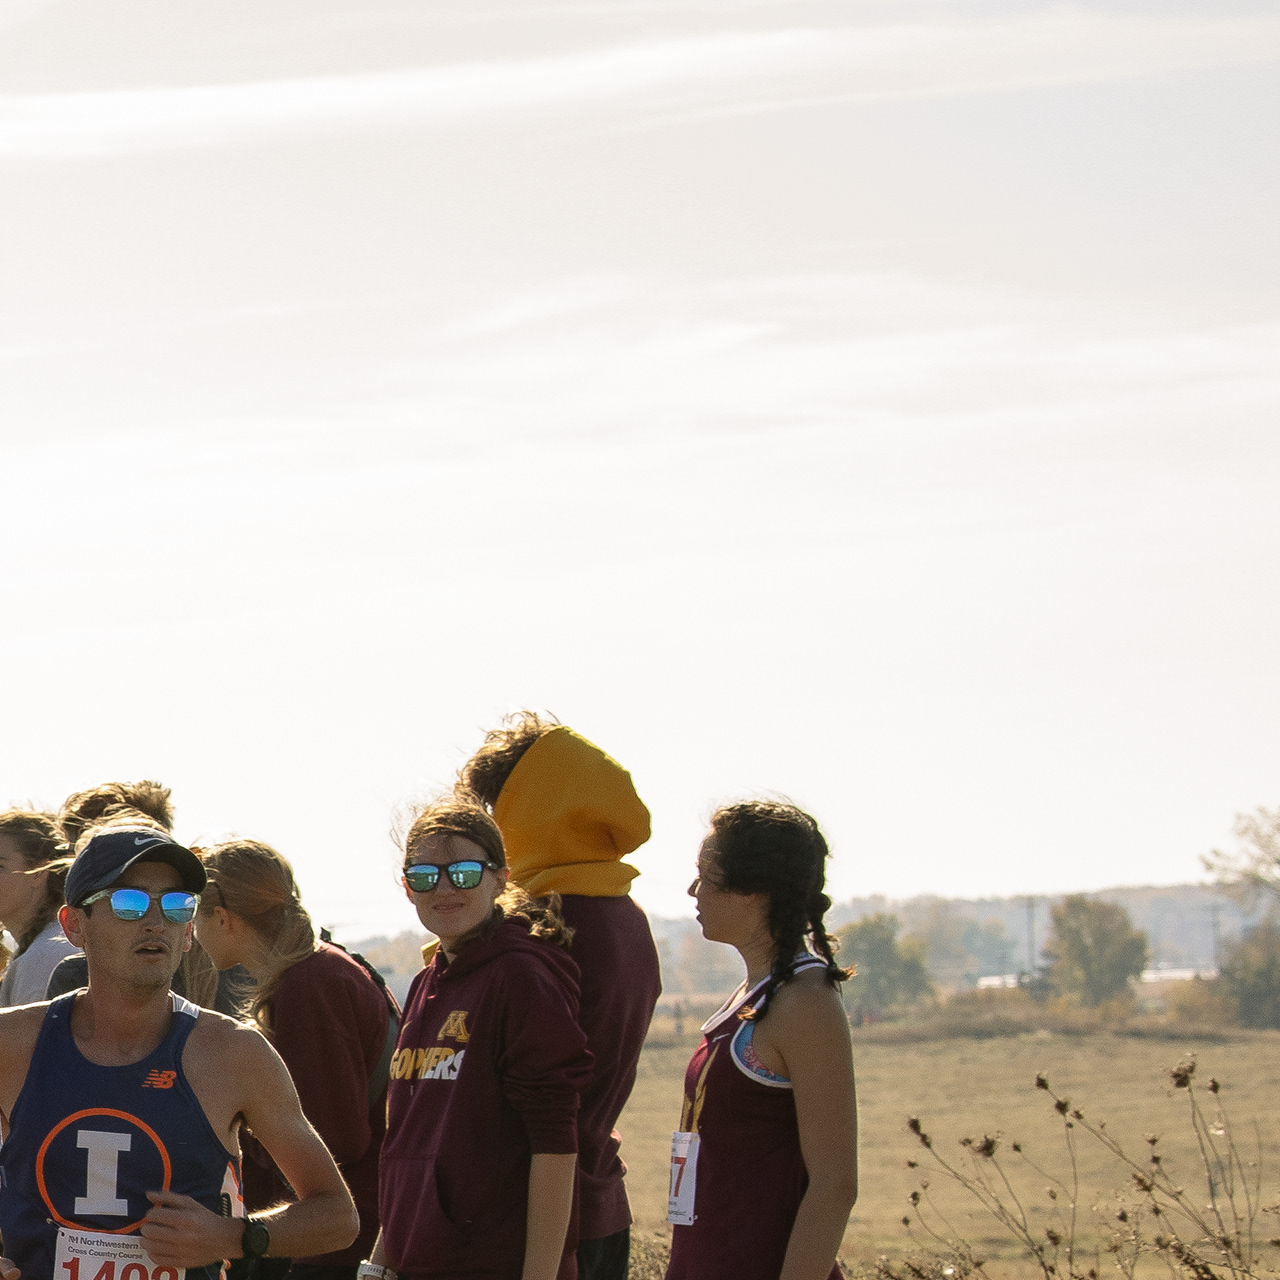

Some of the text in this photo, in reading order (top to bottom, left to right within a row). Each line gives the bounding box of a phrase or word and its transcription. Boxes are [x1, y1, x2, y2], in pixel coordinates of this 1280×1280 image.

[74, 1130, 132, 1216] I
[80, 1238, 138, 1250] Northwestern
[68, 1246, 143, 1260] Cross Country Course
